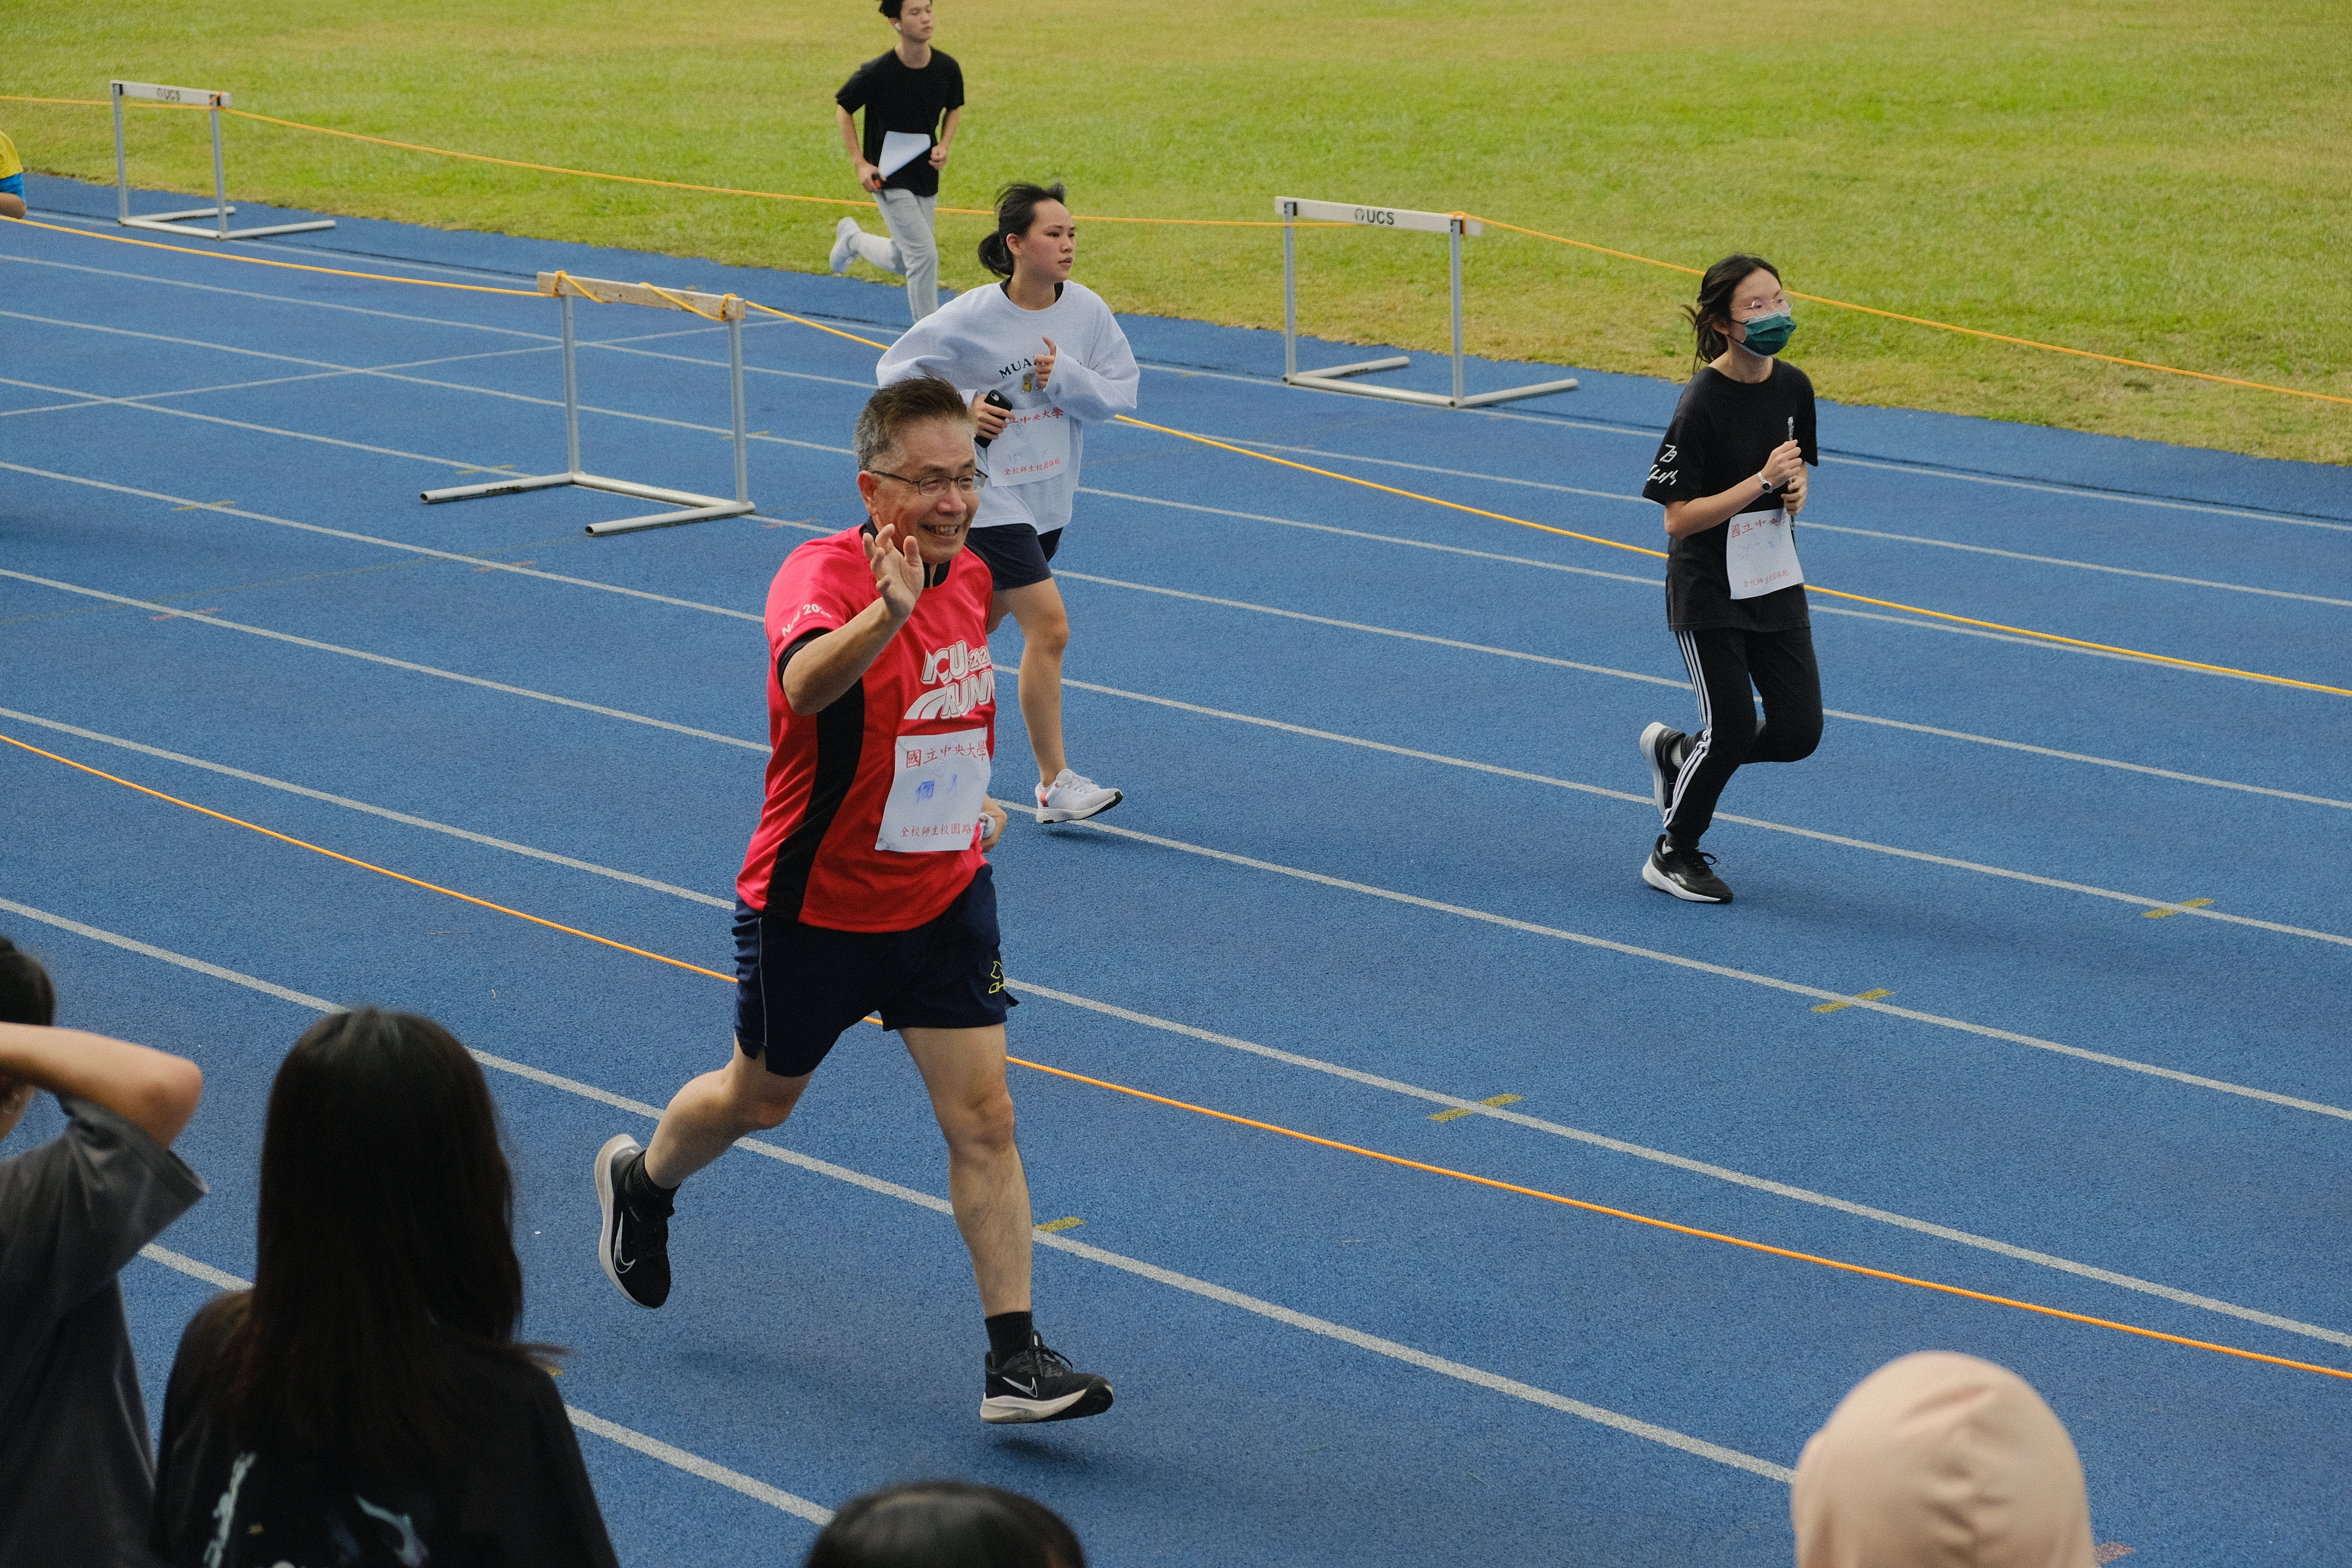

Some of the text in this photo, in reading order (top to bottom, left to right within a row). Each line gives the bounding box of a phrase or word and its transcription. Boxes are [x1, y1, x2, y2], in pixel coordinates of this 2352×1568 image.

[1367, 210, 1394, 225] UCS
[906, 740, 987, 769] 國立中央大學
[900, 823, 979, 837] 全校師生校園路
